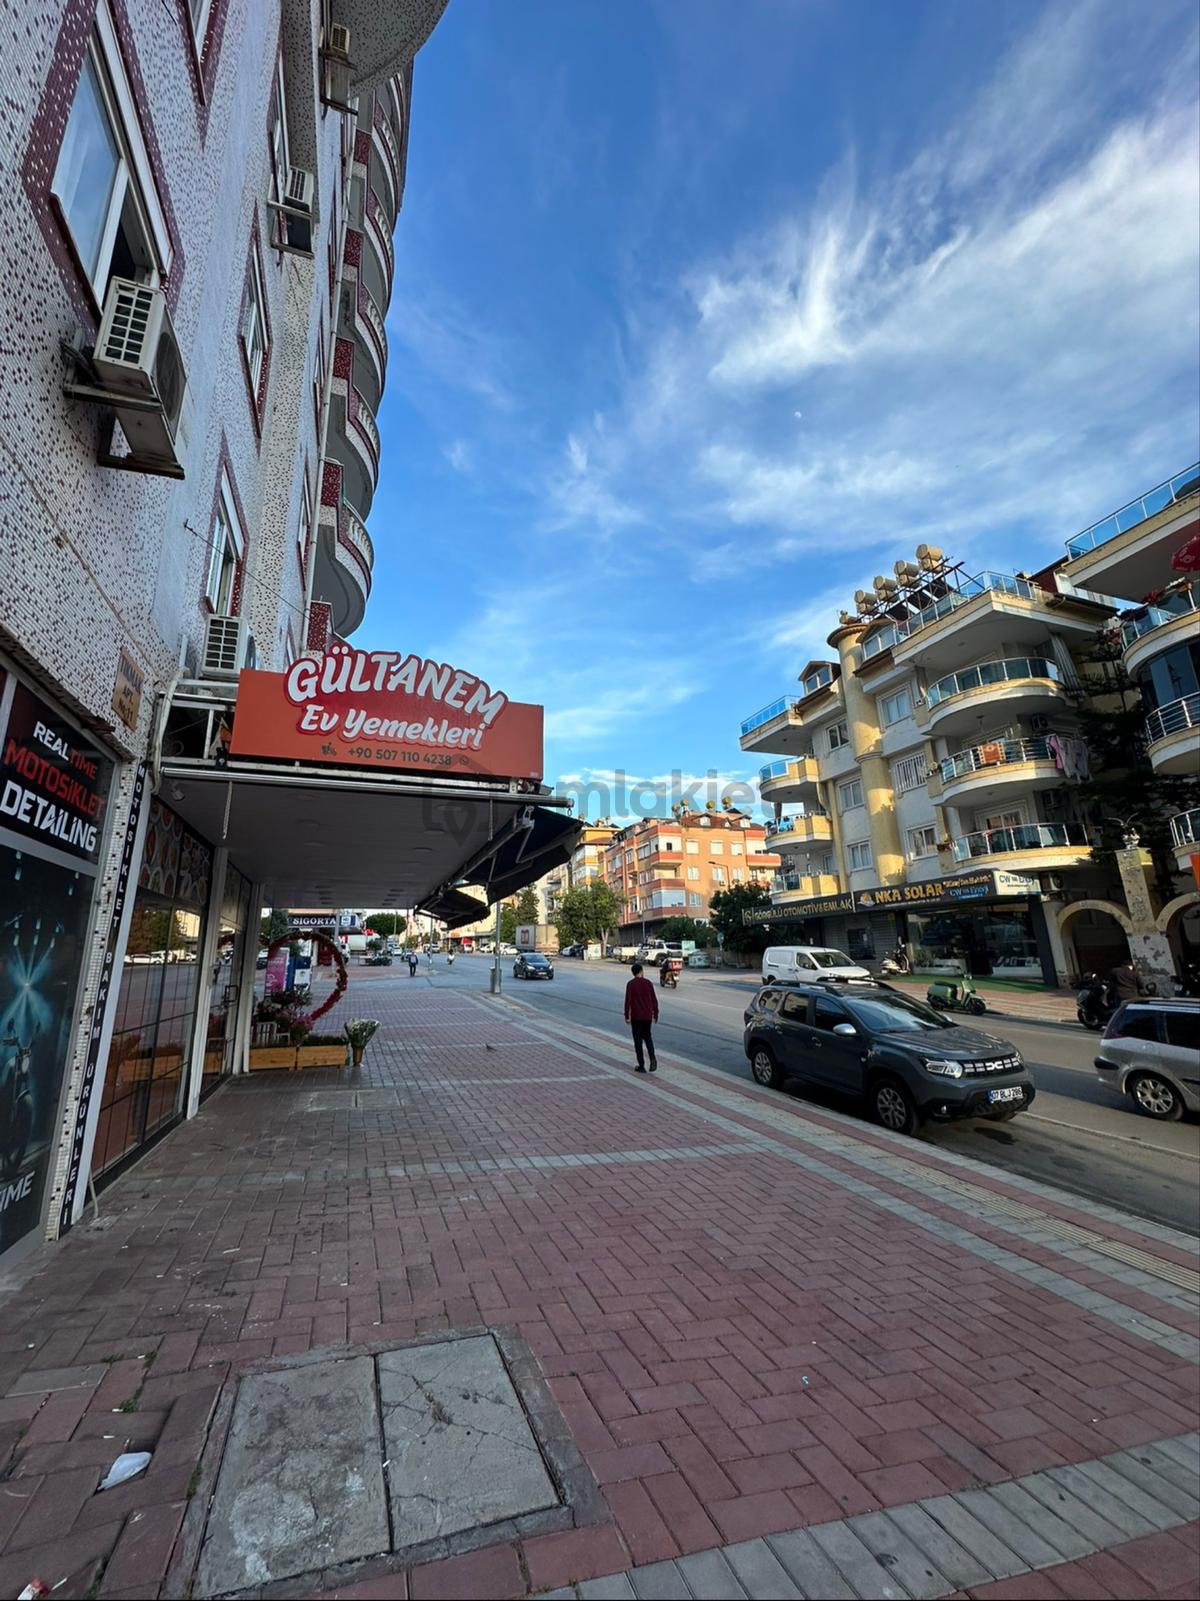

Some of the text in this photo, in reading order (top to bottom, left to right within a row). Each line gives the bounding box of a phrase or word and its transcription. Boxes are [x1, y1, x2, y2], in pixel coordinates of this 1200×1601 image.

[288, 645, 505, 725] GÜLTANEM
[300, 704, 486, 748] Ev Yemekleri
[348, 747, 452, 765] +90 507 110 4238
[875, 889, 902, 904] NKA
[905, 883, 945, 900] SOLAR
[92, 951, 113, 1039] BAKIM
